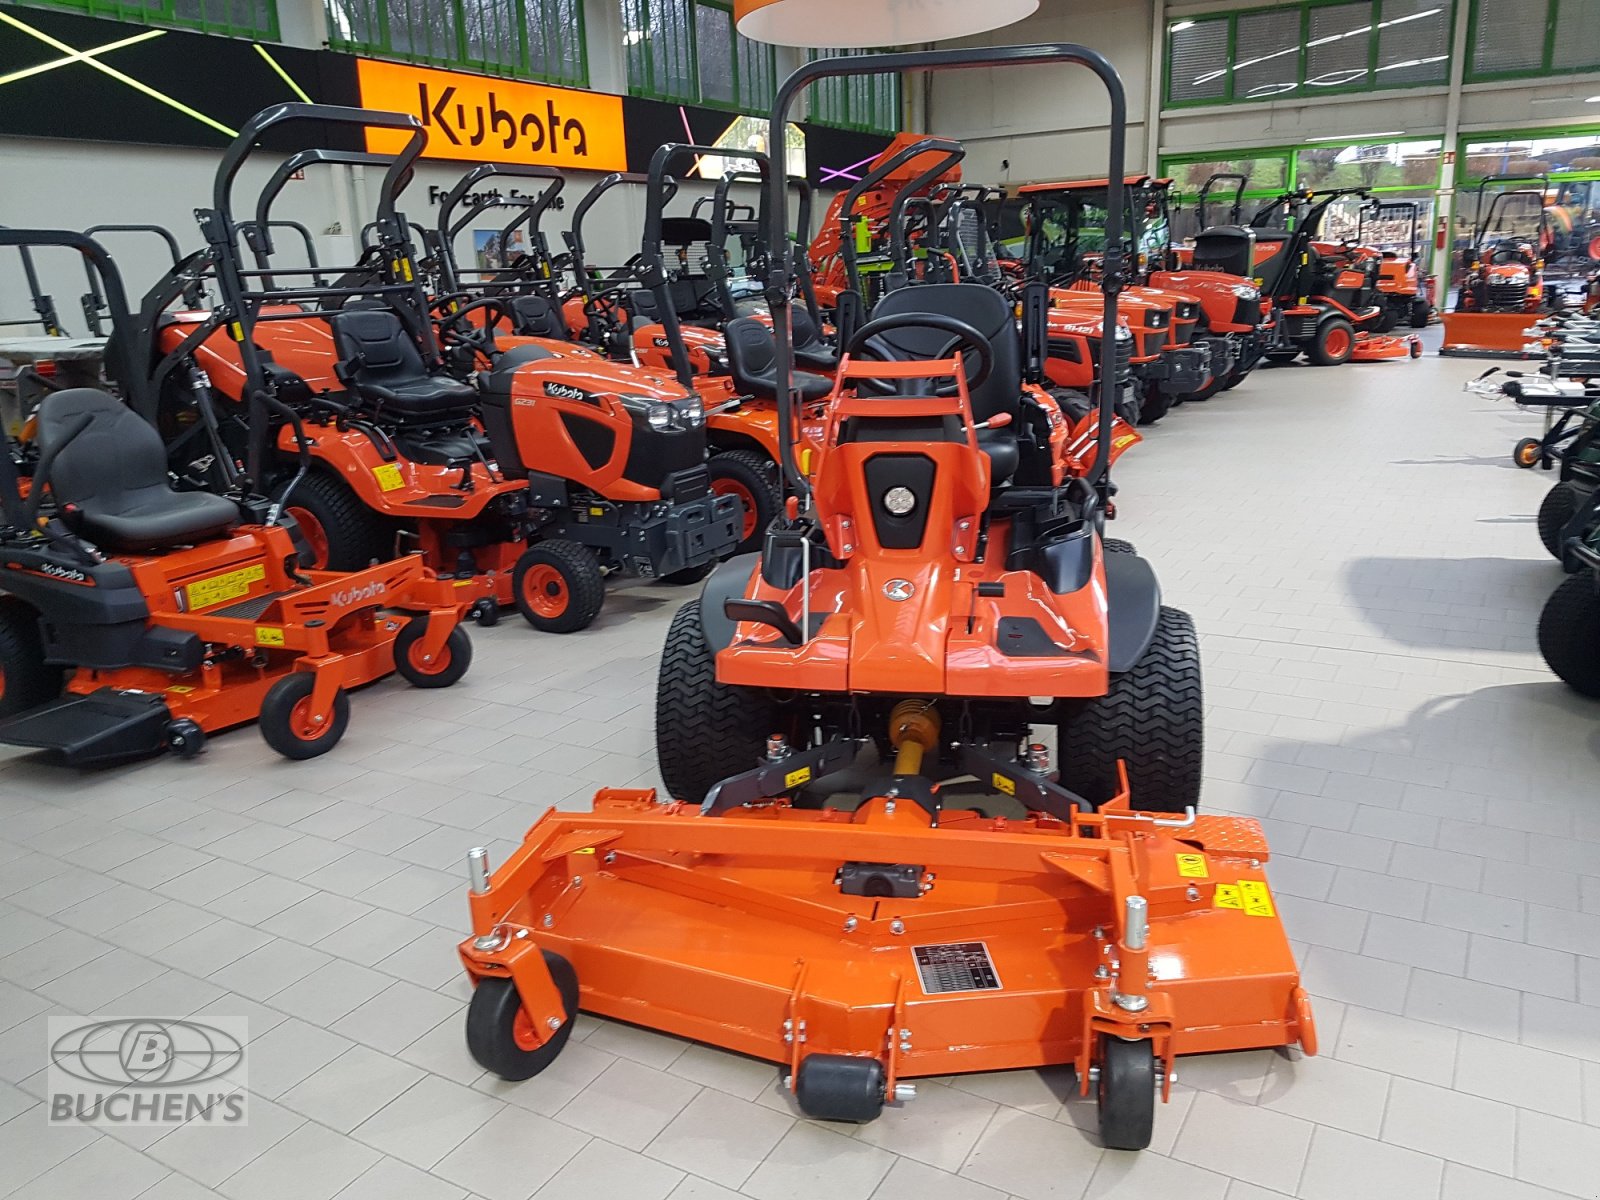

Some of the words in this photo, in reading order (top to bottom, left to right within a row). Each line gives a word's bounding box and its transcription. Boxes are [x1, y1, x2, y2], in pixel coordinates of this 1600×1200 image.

[418, 82, 588, 157] Kubota
[429, 185, 451, 205] Fo
[547, 382, 584, 401] Kubota
[41, 563, 85, 581] Kubota
[330, 581, 386, 607] Kubota
